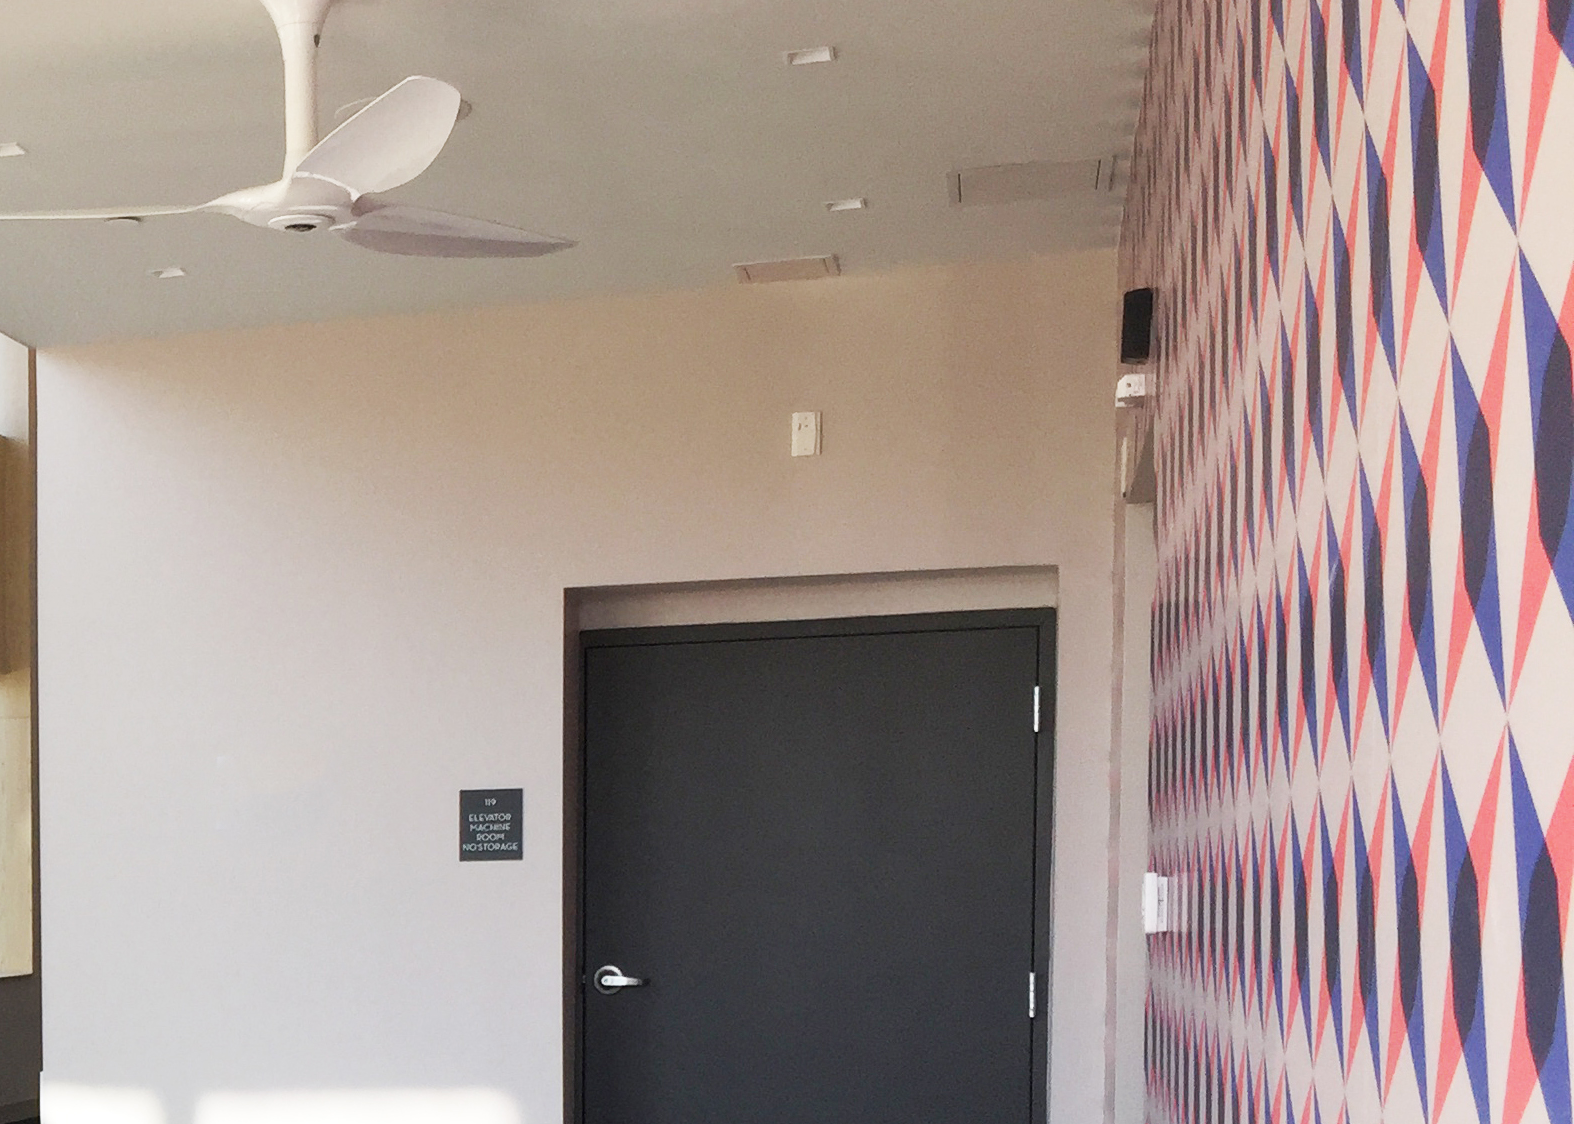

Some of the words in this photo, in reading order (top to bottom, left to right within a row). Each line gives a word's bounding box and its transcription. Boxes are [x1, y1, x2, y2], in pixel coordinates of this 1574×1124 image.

[468, 813, 512, 822] ELEVATOR
[469, 823, 511, 832] MACHINE
[476, 833, 505, 841] ROOM
